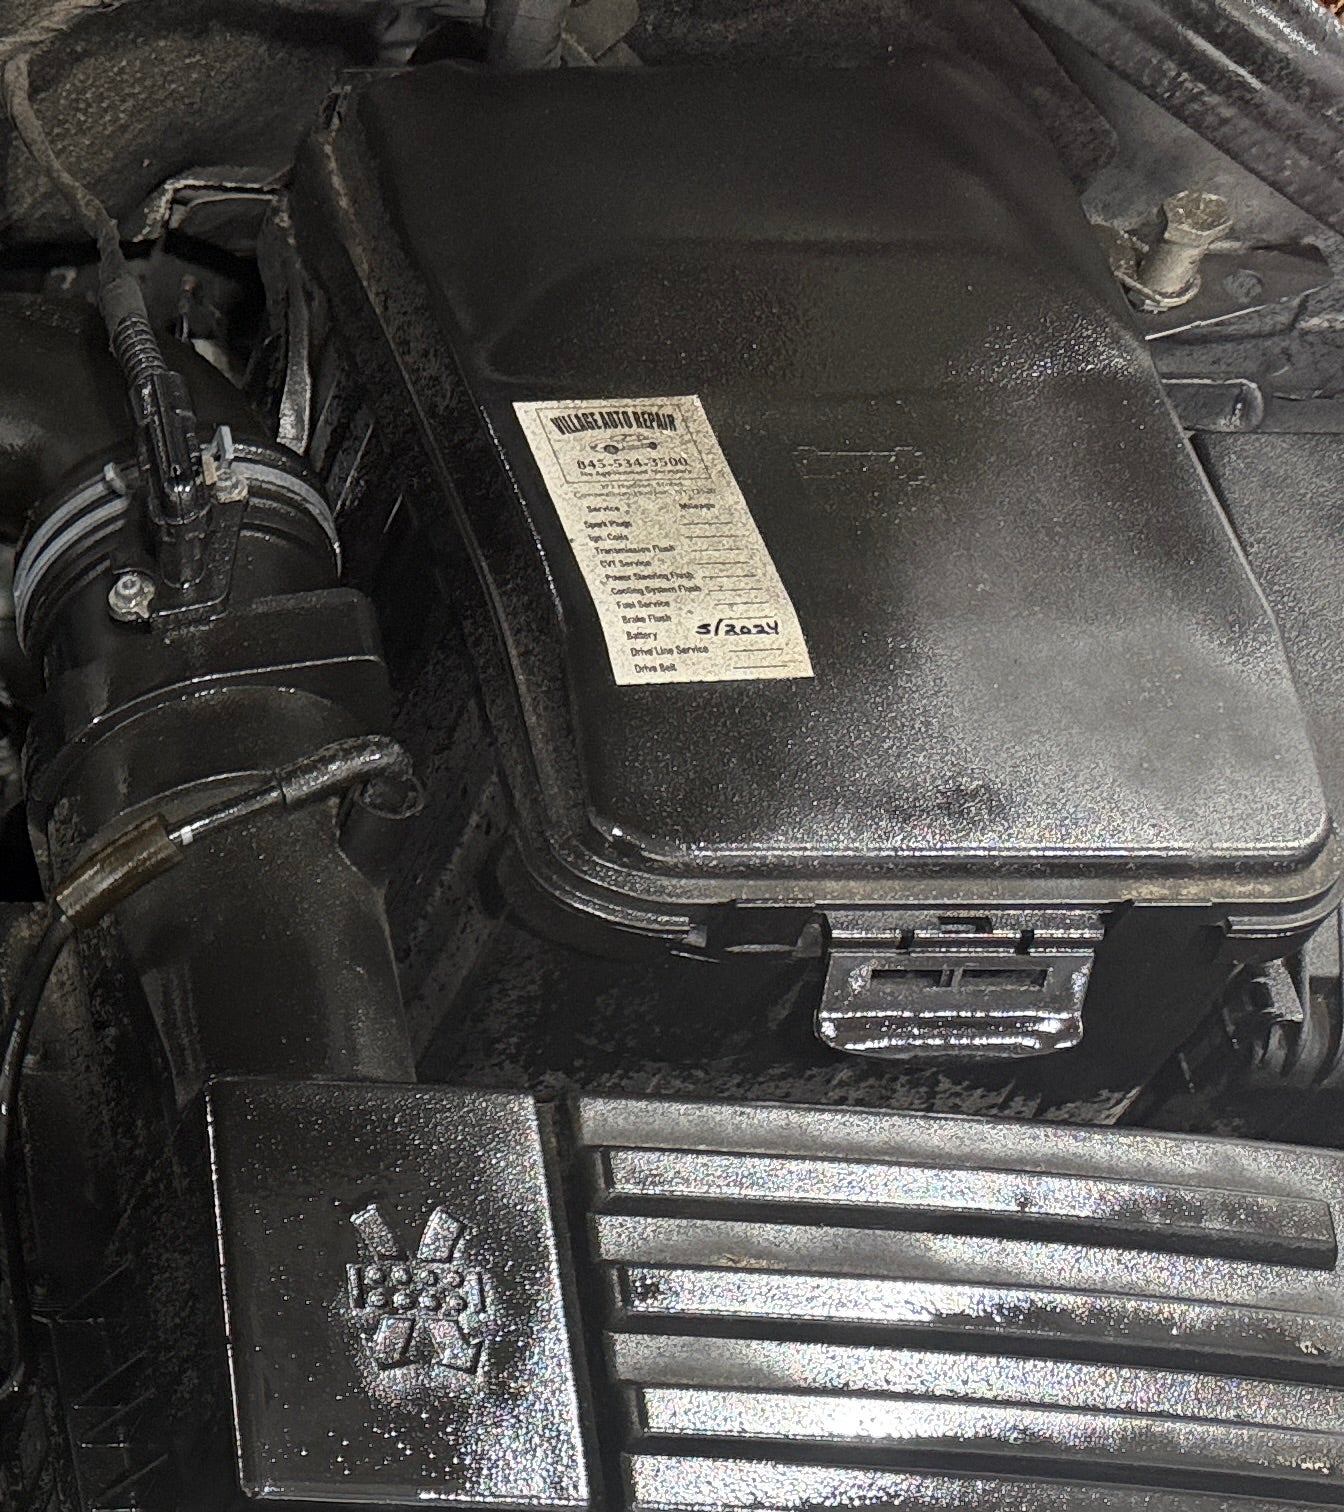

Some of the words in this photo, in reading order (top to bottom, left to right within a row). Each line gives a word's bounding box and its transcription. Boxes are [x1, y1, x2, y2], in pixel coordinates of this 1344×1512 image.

[550, 412, 602, 435] VILLAGE
[601, 411, 633, 429] AUTO
[632, 411, 676, 432] REPAIR
[594, 546, 651, 554] Transmission
[611, 587, 644, 595] Cooling
[645, 586, 677, 594] System
[626, 631, 658, 640] Battery
[630, 648, 653, 657] Drive
[655, 647, 674, 655] Line
[675, 645, 709, 654] Service
[634, 664, 657, 673] Drive
[659, 663, 677, 672] Belt
